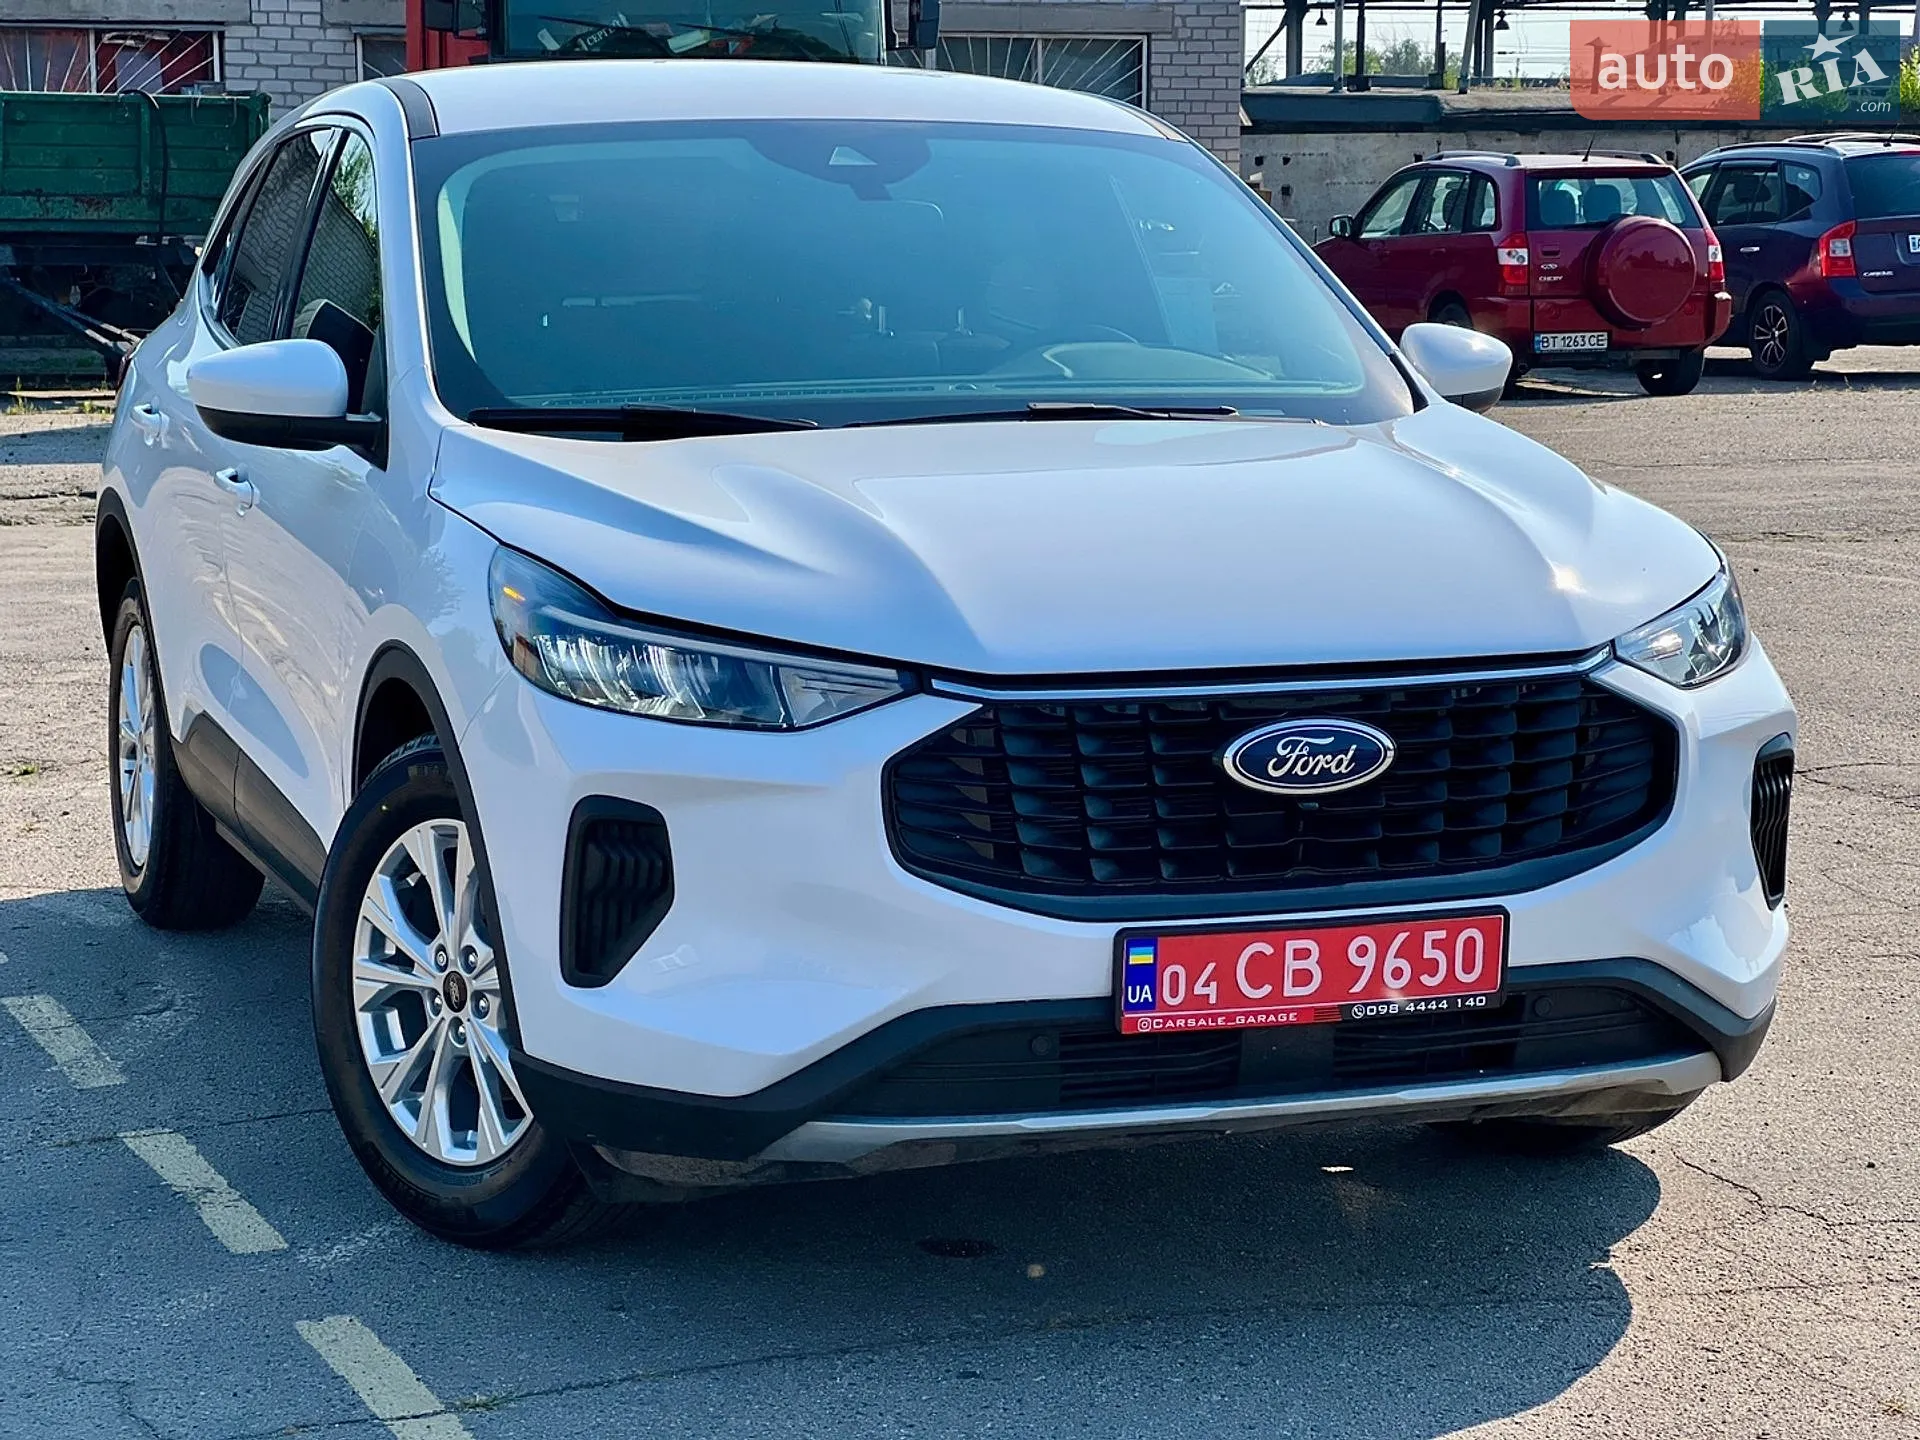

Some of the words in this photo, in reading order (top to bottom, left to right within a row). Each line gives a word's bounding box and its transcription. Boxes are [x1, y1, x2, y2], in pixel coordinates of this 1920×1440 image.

[1541, 335, 1558, 349] BT
[1560, 335, 1587, 348] 1263
[1588, 334, 1605, 347] CE
[1267, 736, 1357, 777] Ford
[1162, 962, 1218, 1006] 04
[1236, 939, 1323, 999] CB
[1347, 927, 1485, 994] 9650
[1127, 985, 1153, 1004] UA
[1366, 1004, 1399, 1016] 098
[1405, 1000, 1448, 1012] 4444
[1457, 996, 1486, 1008] 140
[1152, 1012, 1298, 1030] CARSALE_GARAGE
